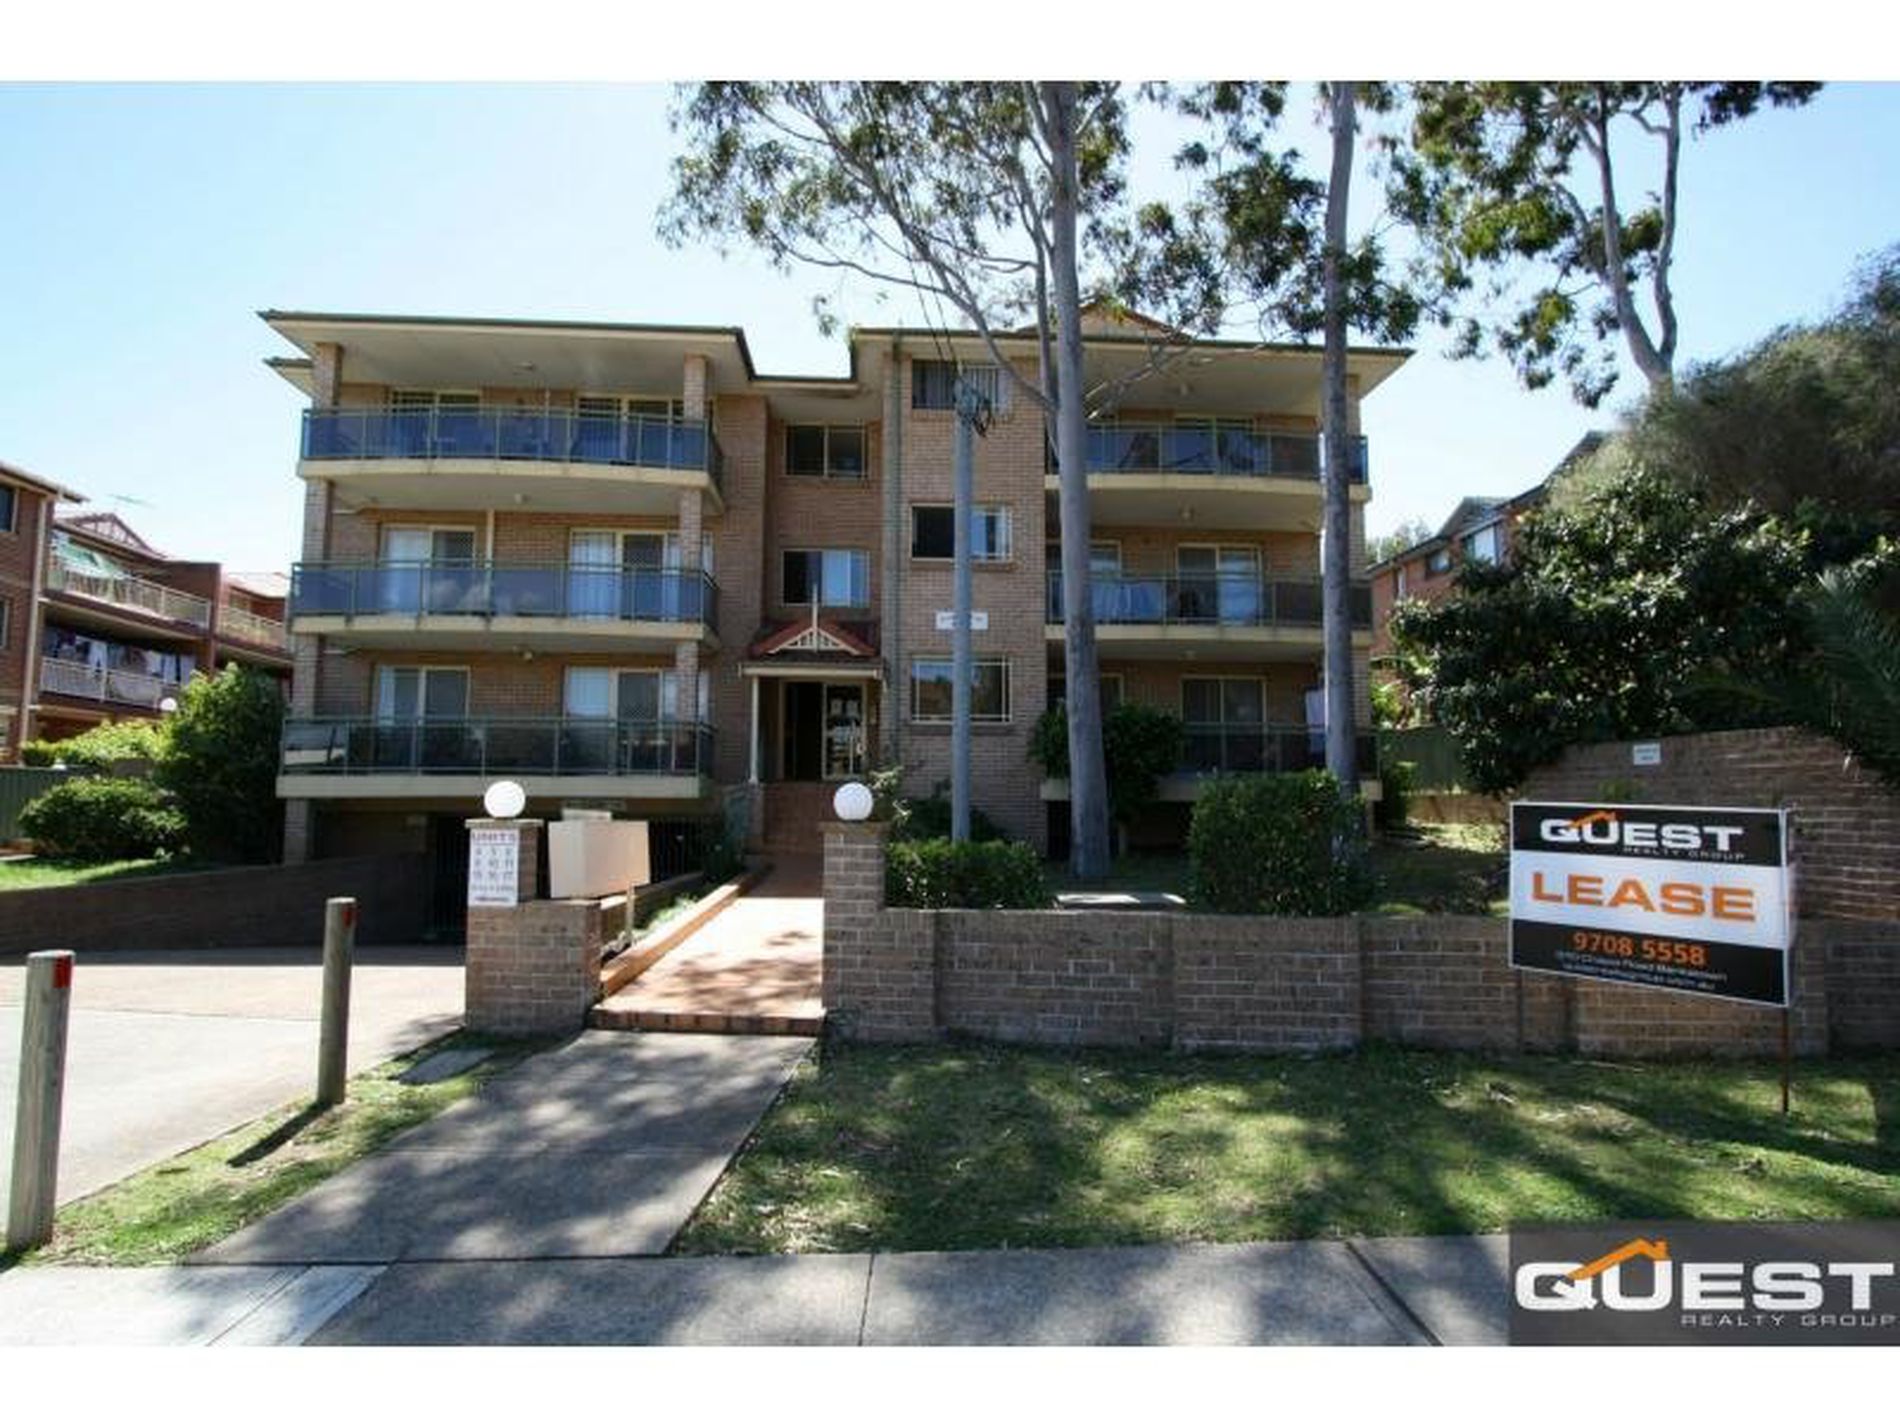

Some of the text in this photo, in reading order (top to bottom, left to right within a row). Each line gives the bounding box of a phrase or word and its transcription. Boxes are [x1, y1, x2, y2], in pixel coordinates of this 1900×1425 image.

[1540, 819, 1743, 850] QUEST
[1689, 850, 1745, 861] GROUP
[1532, 872, 1756, 921] LEASE
[1573, 932, 1633, 957] 9708
[1641, 940, 1707, 966] 5558
